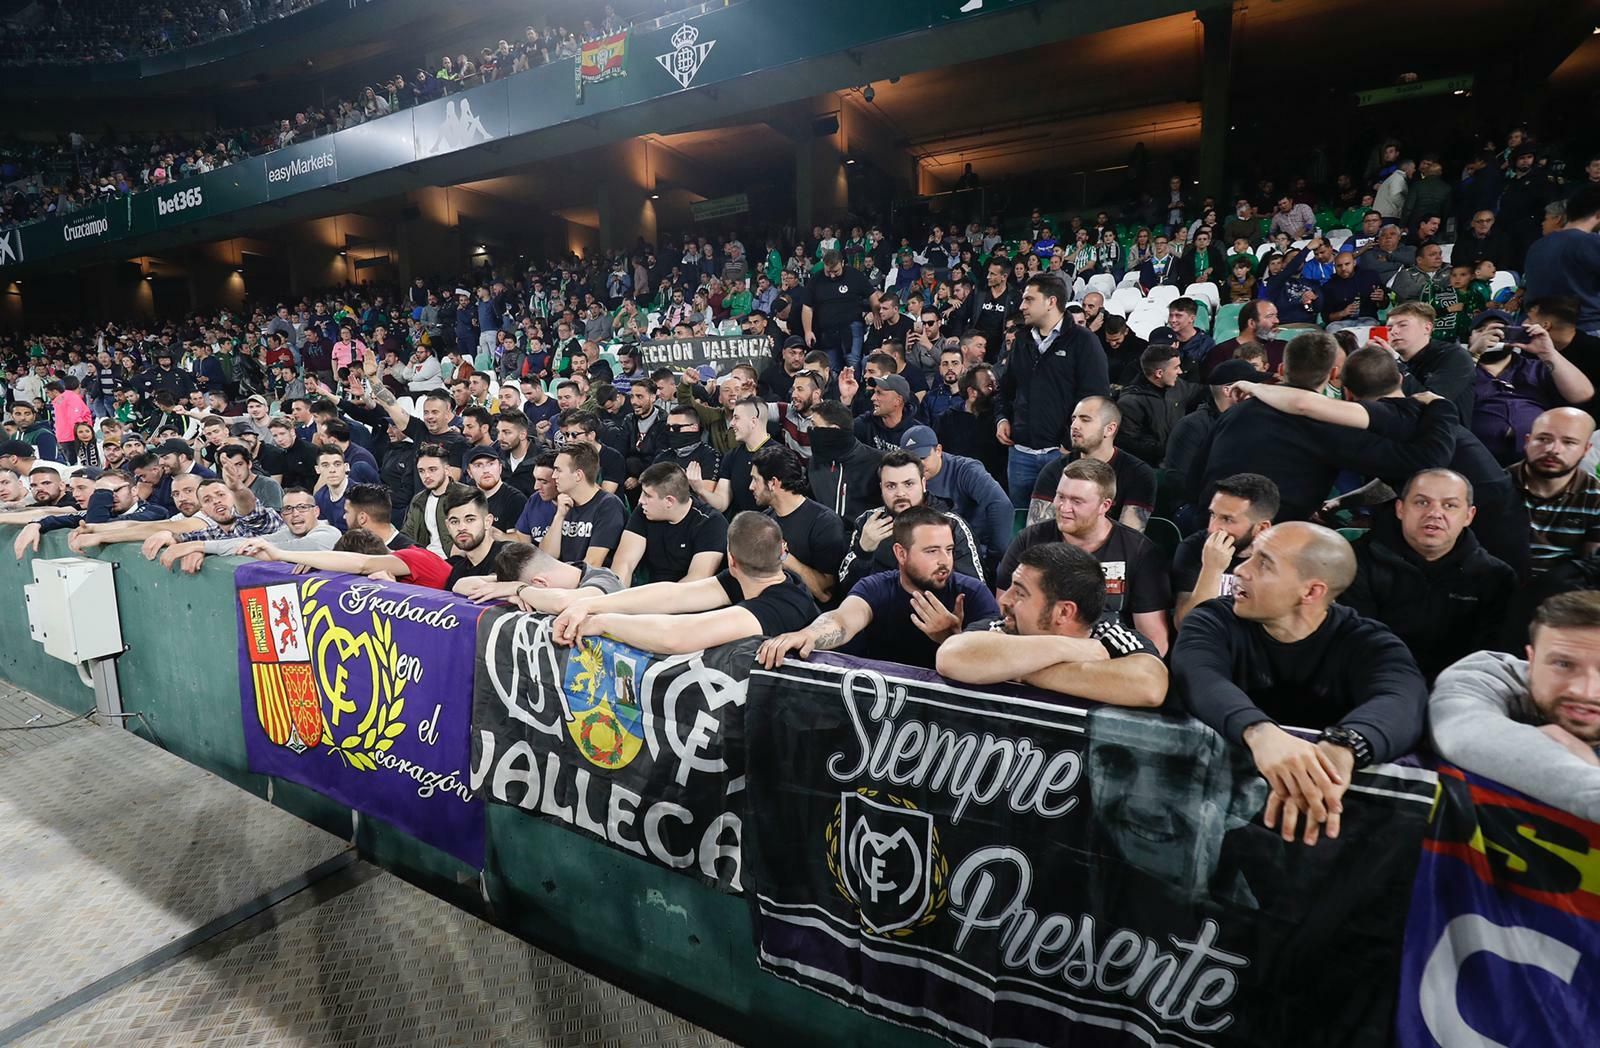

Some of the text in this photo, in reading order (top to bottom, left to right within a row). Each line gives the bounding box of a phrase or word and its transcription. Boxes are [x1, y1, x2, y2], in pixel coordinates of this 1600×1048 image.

[268, 152, 334, 183] easyMarkets
[157, 186, 203, 215] bet365
[63, 217, 108, 241] Cruzcampo
[641, 340, 693, 363] ECCIÓN
[396, 654, 423, 683] en
[418, 704, 442, 746] el
[827, 668, 1083, 825] Siempre
[374, 749, 473, 803] corazón
[949, 845, 1251, 1032] Presente
